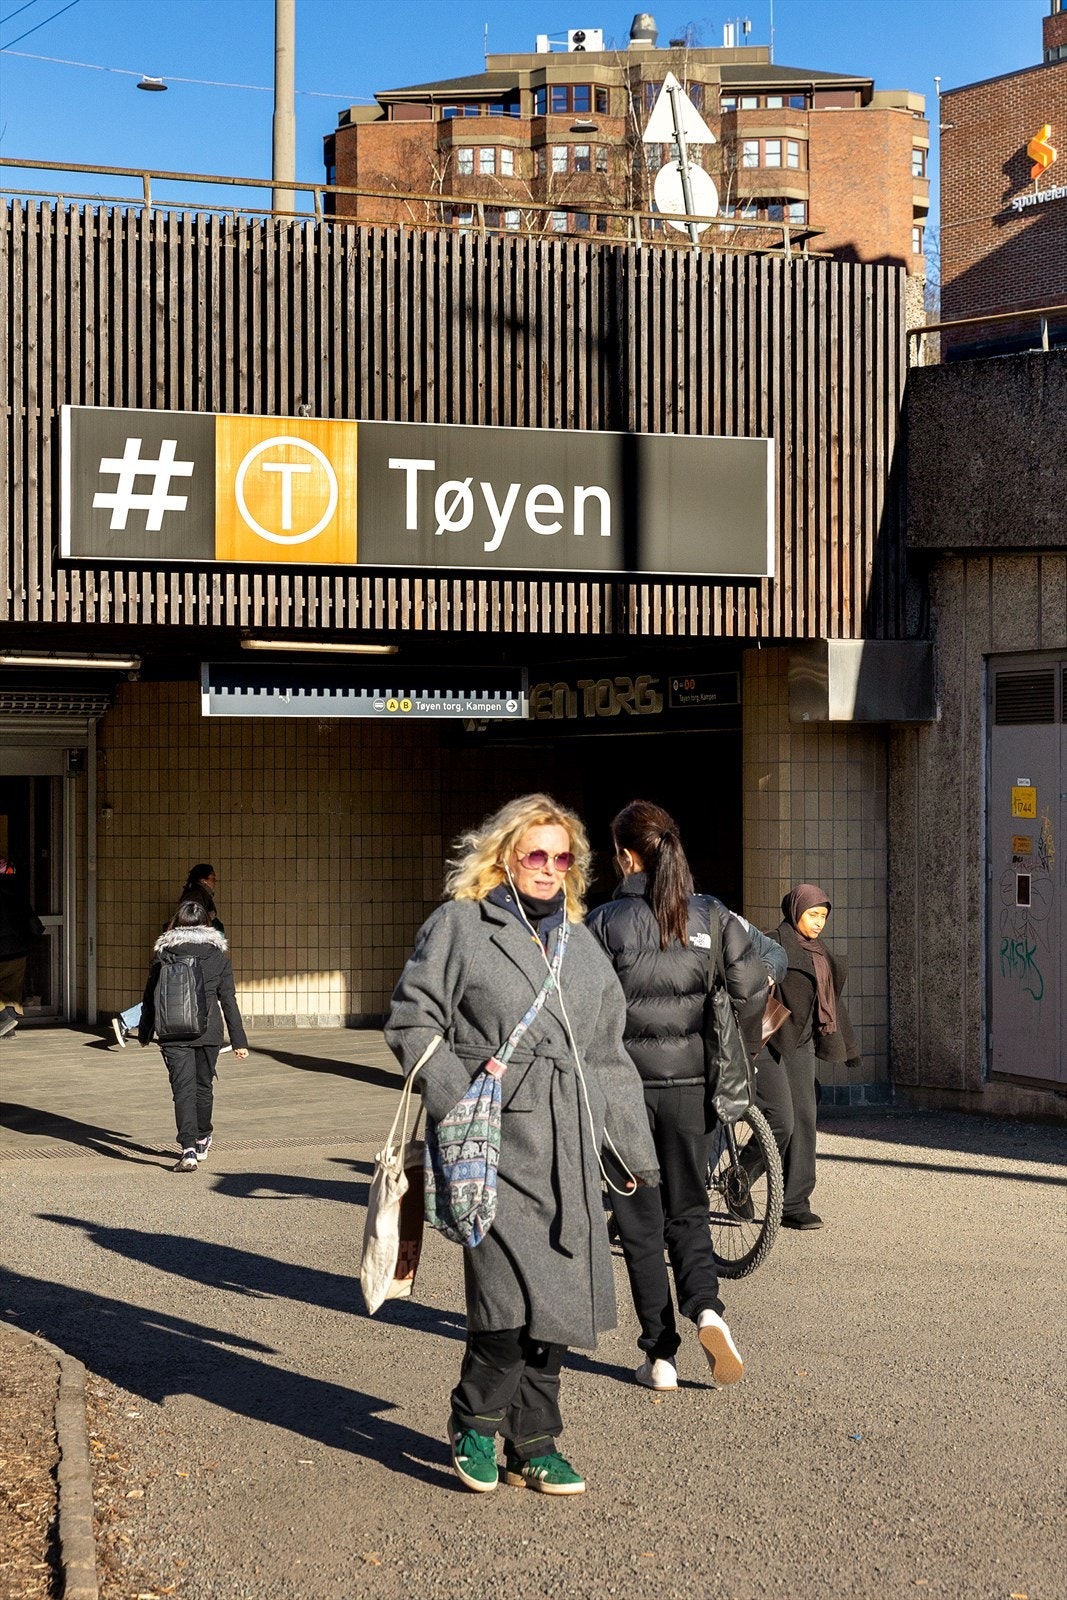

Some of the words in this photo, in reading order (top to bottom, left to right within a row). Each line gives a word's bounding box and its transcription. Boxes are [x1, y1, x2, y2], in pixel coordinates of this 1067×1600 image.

[261, 462, 312, 530] T
[388, 458, 611, 552] Tøyen
[415, 701, 441, 712] Tøyen
[443, 702, 464, 712] torg,
[466, 701, 502, 712] Kampen
